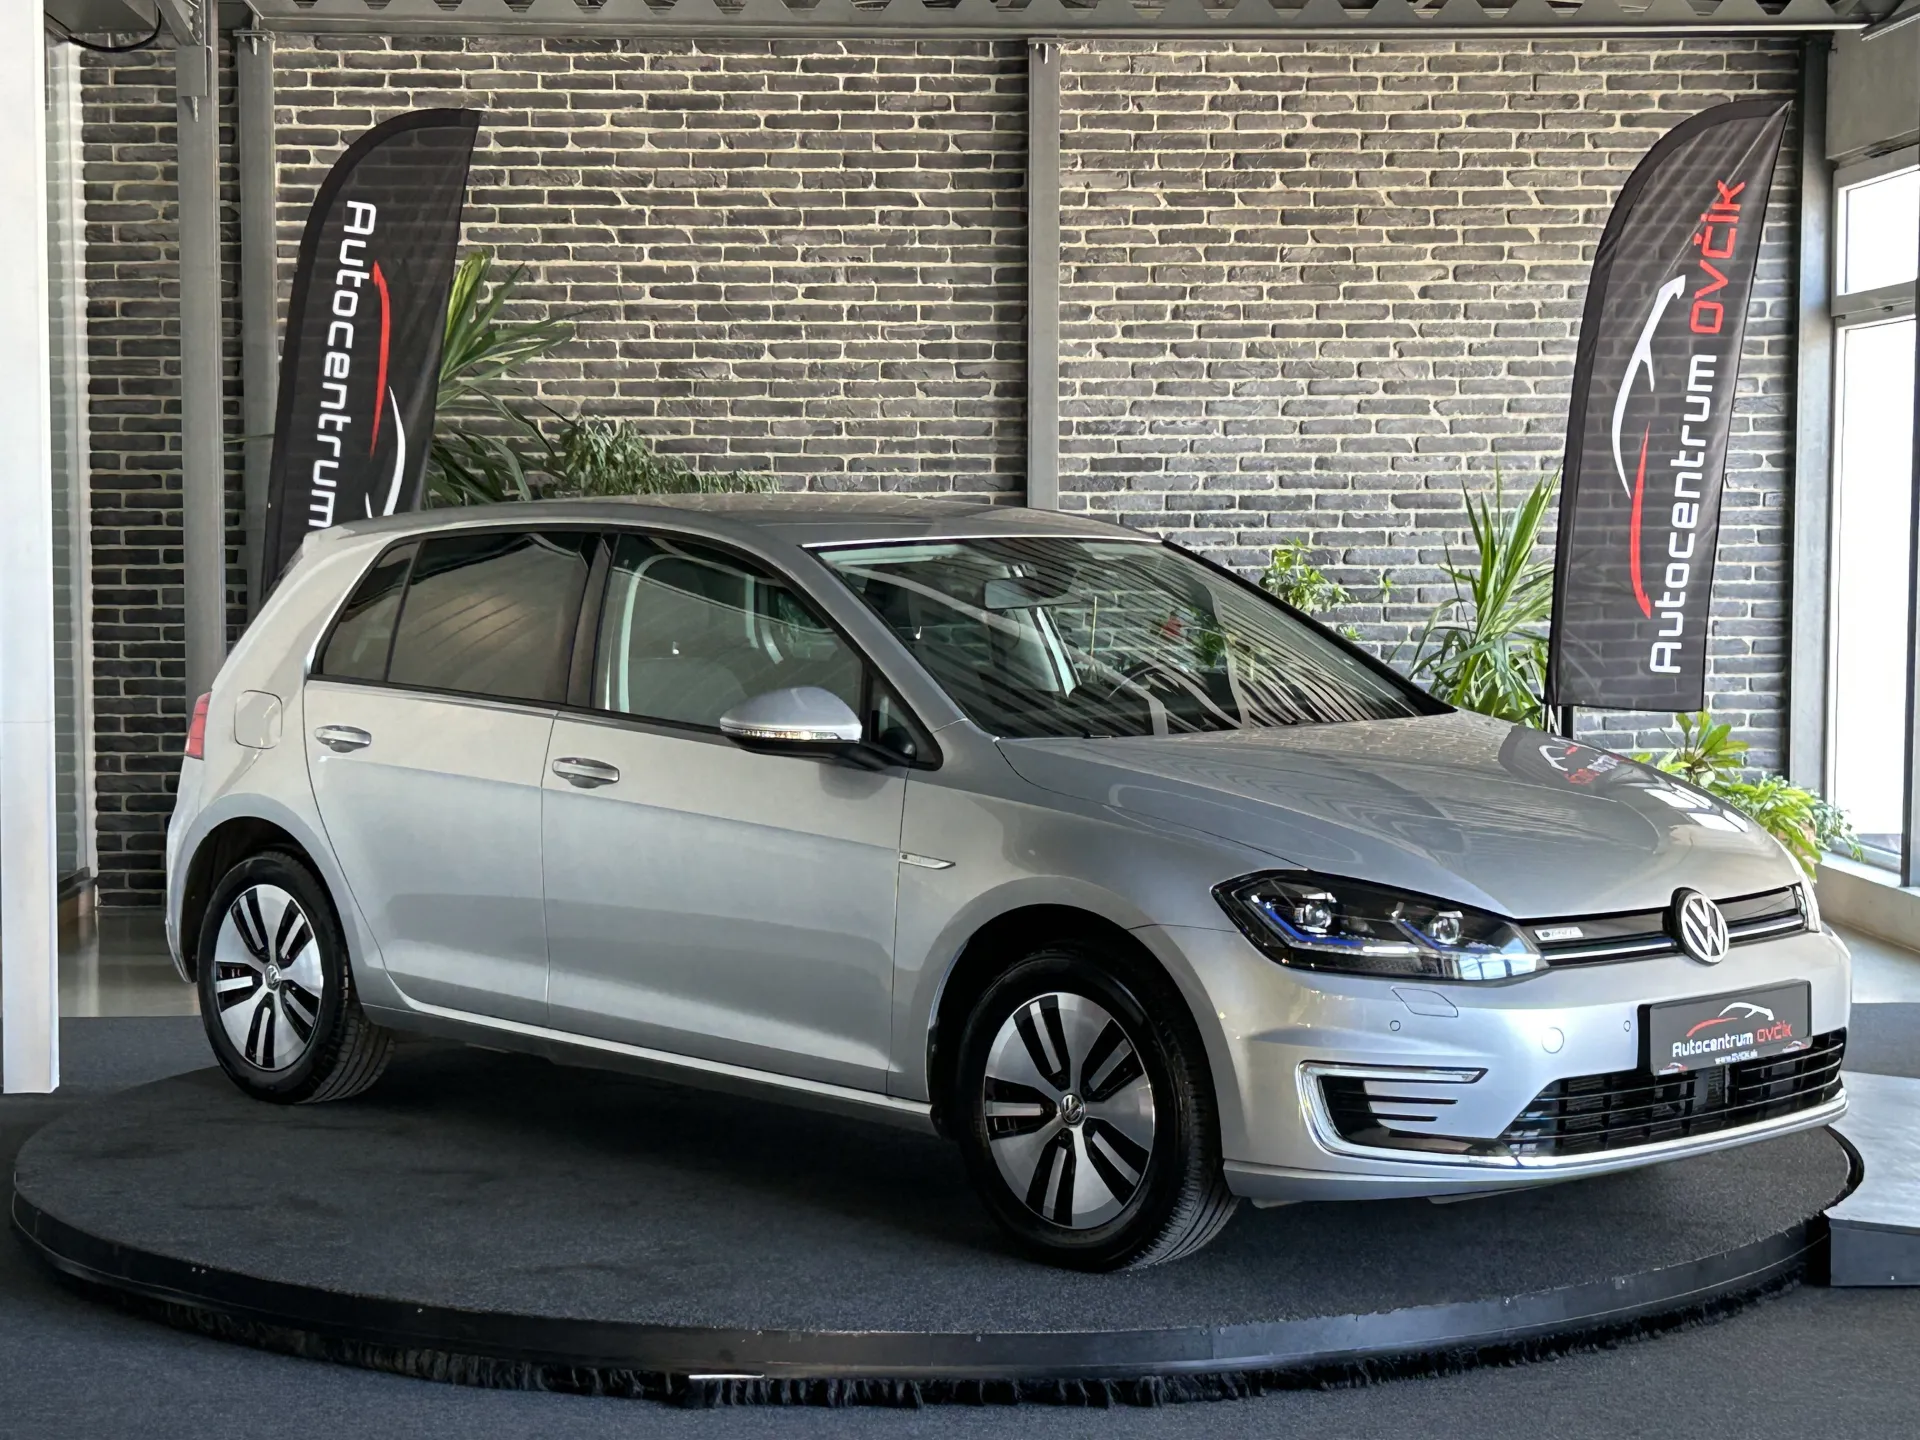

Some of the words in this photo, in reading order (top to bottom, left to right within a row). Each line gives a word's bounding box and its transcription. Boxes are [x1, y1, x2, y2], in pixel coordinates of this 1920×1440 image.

[308, 200, 377, 528] Autocentrum
[1650, 354, 1717, 674] Autocentrum
[1672, 1032, 1754, 1058] Autocentrum
